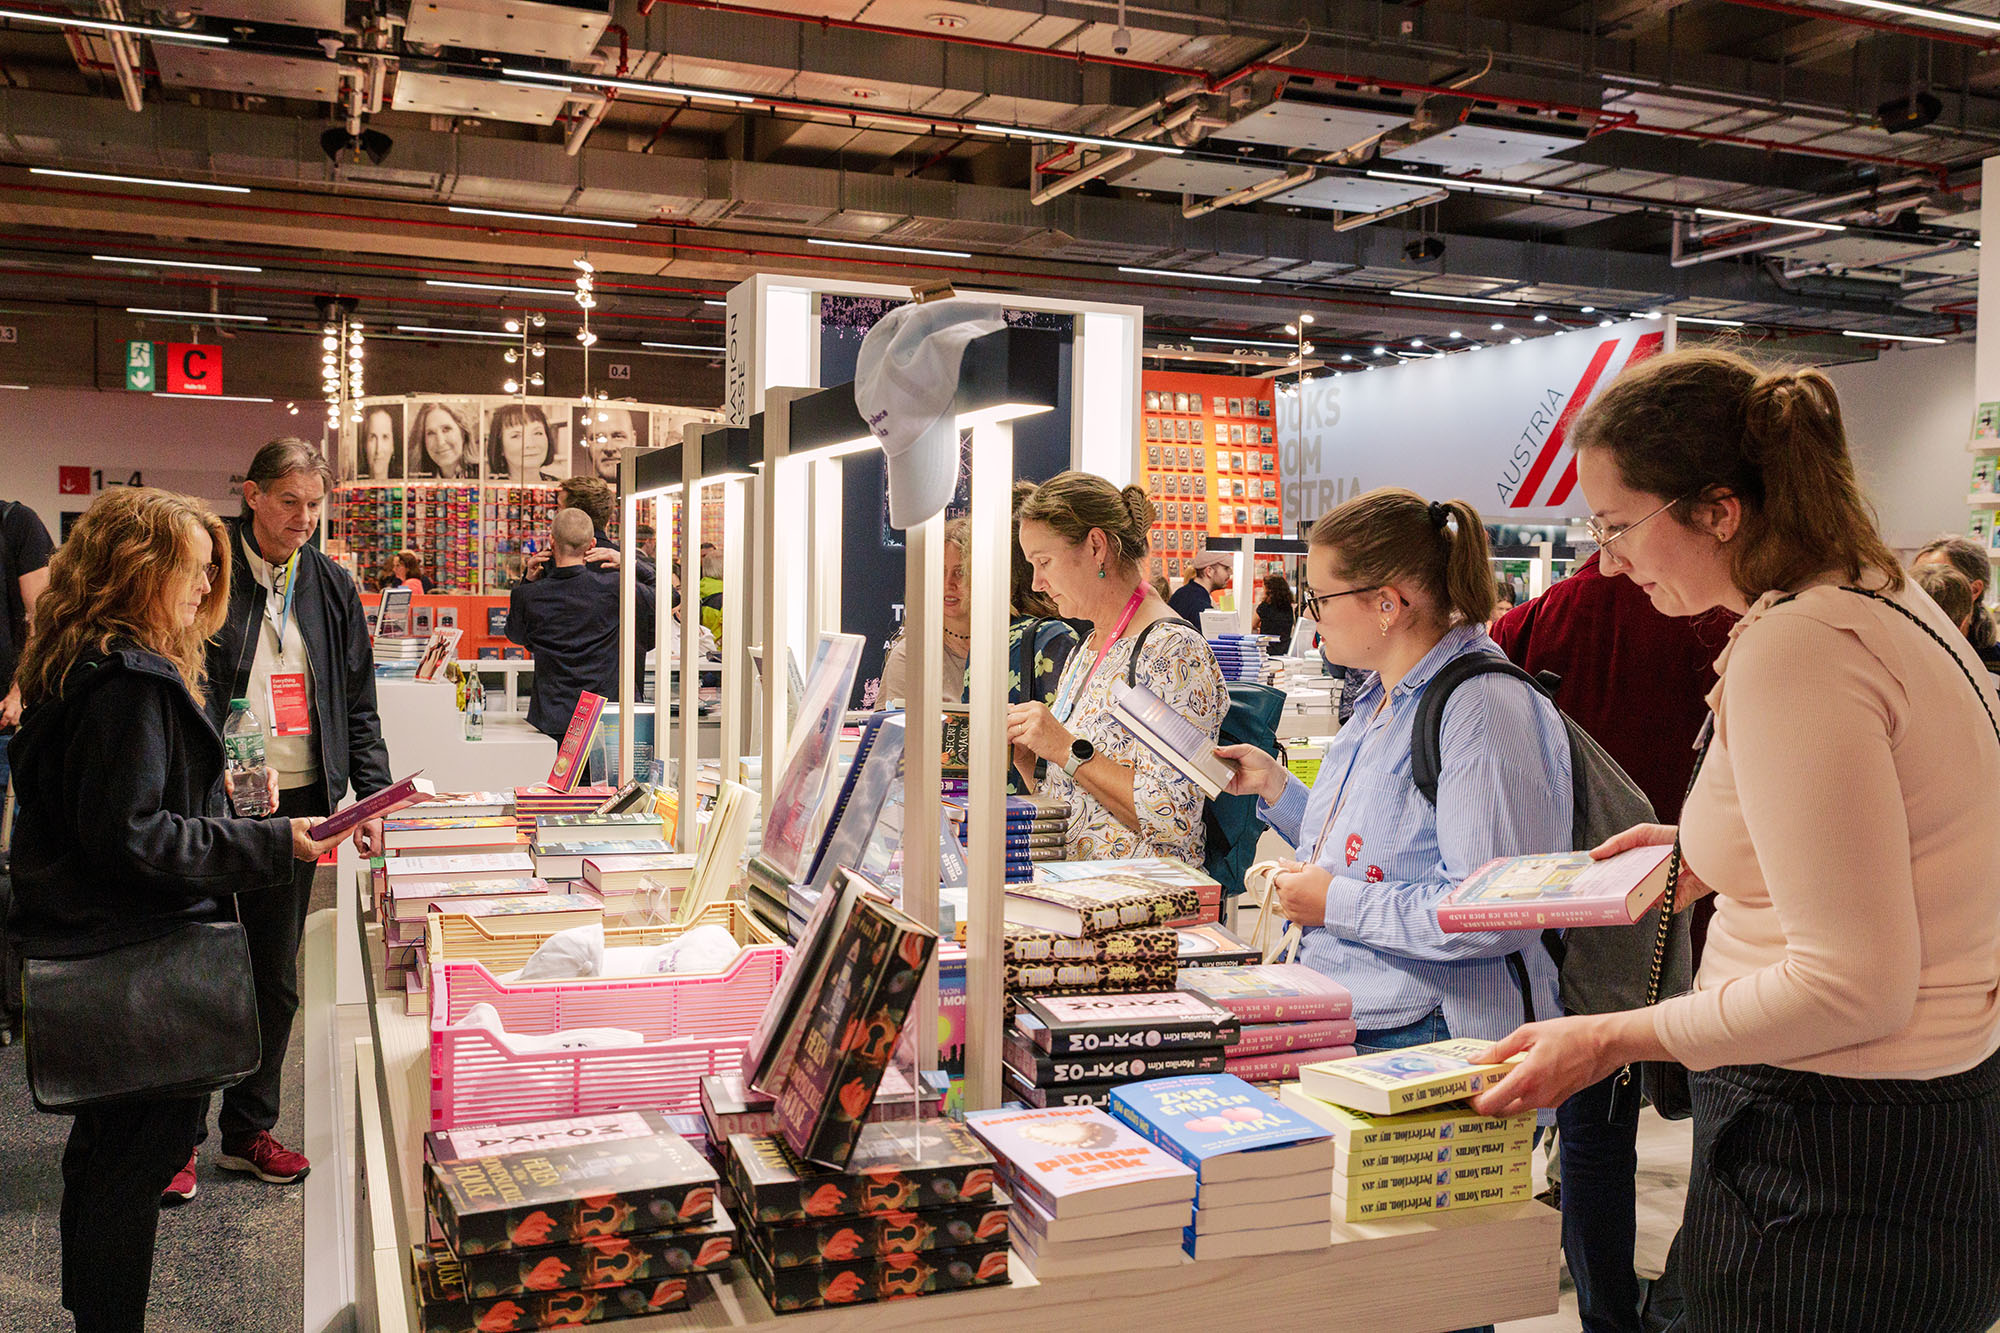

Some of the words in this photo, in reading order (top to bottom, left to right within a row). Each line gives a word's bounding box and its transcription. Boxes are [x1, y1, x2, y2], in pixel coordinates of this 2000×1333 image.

[0, 328, 14, 340] .3
[183, 350, 207, 380] C
[611, 366, 628, 377] 0.4
[1496, 388, 1565, 505] AUSTRIA
[945, 722, 957, 754] SECRET
[958, 723, 969, 753] MAGIC
[941, 853, 958, 881] CHELSEA
[949, 853, 963, 876] CURTO
[1014, 940, 1050, 959] GIRLS
[1053, 939, 1096, 959] WEIRD
[1019, 967, 1054, 987] GIRLS
[1057, 966, 1098, 985] WEIRD
[1068, 1031, 1145, 1052] MOLKA
[1163, 1032, 1180, 1041] Kim
[1181, 1031, 1212, 1040] Monika
[804, 1028, 831, 1069] HEXEN
[1147, 1062, 1164, 1071] Kim
[1165, 1059, 1195, 1069] Monika
[1053, 1060, 1129, 1082] MOLKA
[1487, 1071, 1508, 1085] orms
[1063, 1093, 1110, 1106] MOL
[1154, 1087, 1219, 1104] ZUM
[1401, 1092, 1415, 1103] ass
[1415, 1090, 1427, 1101] my
[782, 1089, 810, 1131] HOUSE
[1159, 1094, 1251, 1116] ERSTEN
[1221, 1112, 1292, 1136] MAL
[1458, 1121, 1484, 1134] Norms
[1484, 1119, 1508, 1131] Leena
[475, 1124, 623, 1148] MOLKA
[1364, 1133, 1378, 1144] ass
[1380, 1130, 1392, 1140] my
[751, 1139, 788, 1169] HOUSE
[1456, 1145, 1480, 1157] Norms
[1481, 1142, 1504, 1154] Leena
[1033, 1147, 1152, 1173] pillow
[1362, 1157, 1375, 1167] ass
[1376, 1154, 1389, 1165] my
[521, 1156, 561, 1188] HEXEN
[1067, 1157, 1148, 1176] talk
[1455, 1167, 1479, 1179] Norms
[1480, 1165, 1503, 1176] Leena
[453, 1165, 496, 1199] HOUSE
[1361, 1180, 1375, 1191] ass
[1377, 1177, 1389, 1188] my
[1454, 1190, 1479, 1201] Norms
[1480, 1187, 1503, 1199] Leena
[1360, 1203, 1374, 1213] ass
[1375, 1200, 1388, 1211] my
